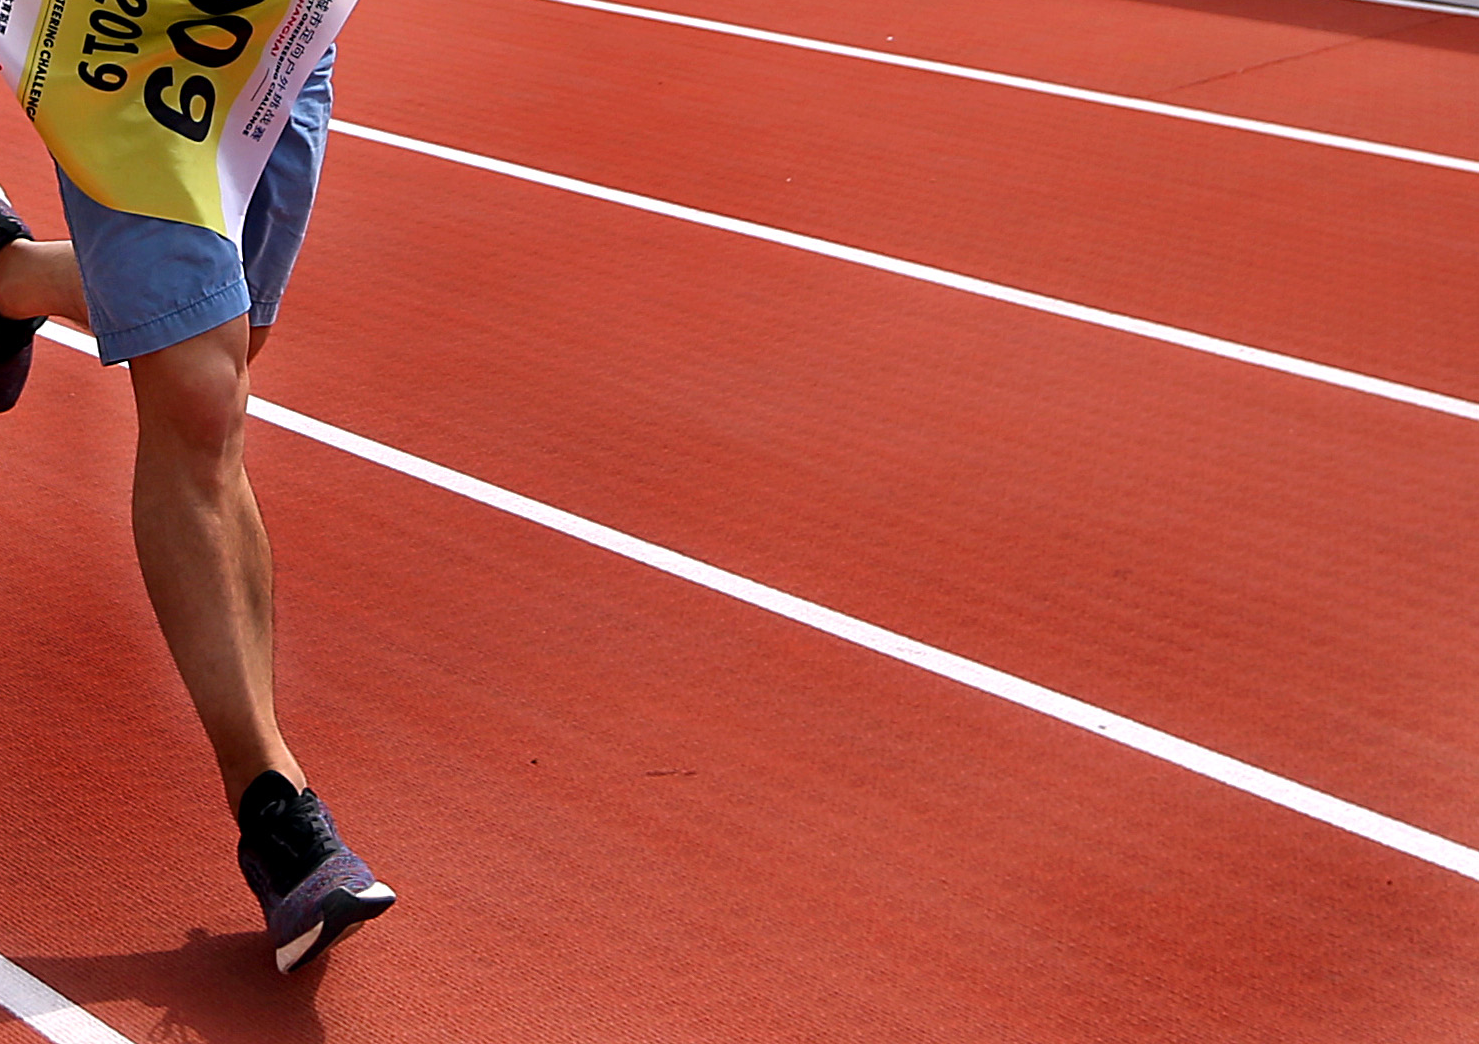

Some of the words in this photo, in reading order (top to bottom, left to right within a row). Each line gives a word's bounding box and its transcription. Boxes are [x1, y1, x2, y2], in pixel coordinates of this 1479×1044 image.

[274, 13, 309, 82] ORIENTEERING
[25, 49, 52, 123] CHALLENG
[242, 81, 277, 137] CHALLENGE
